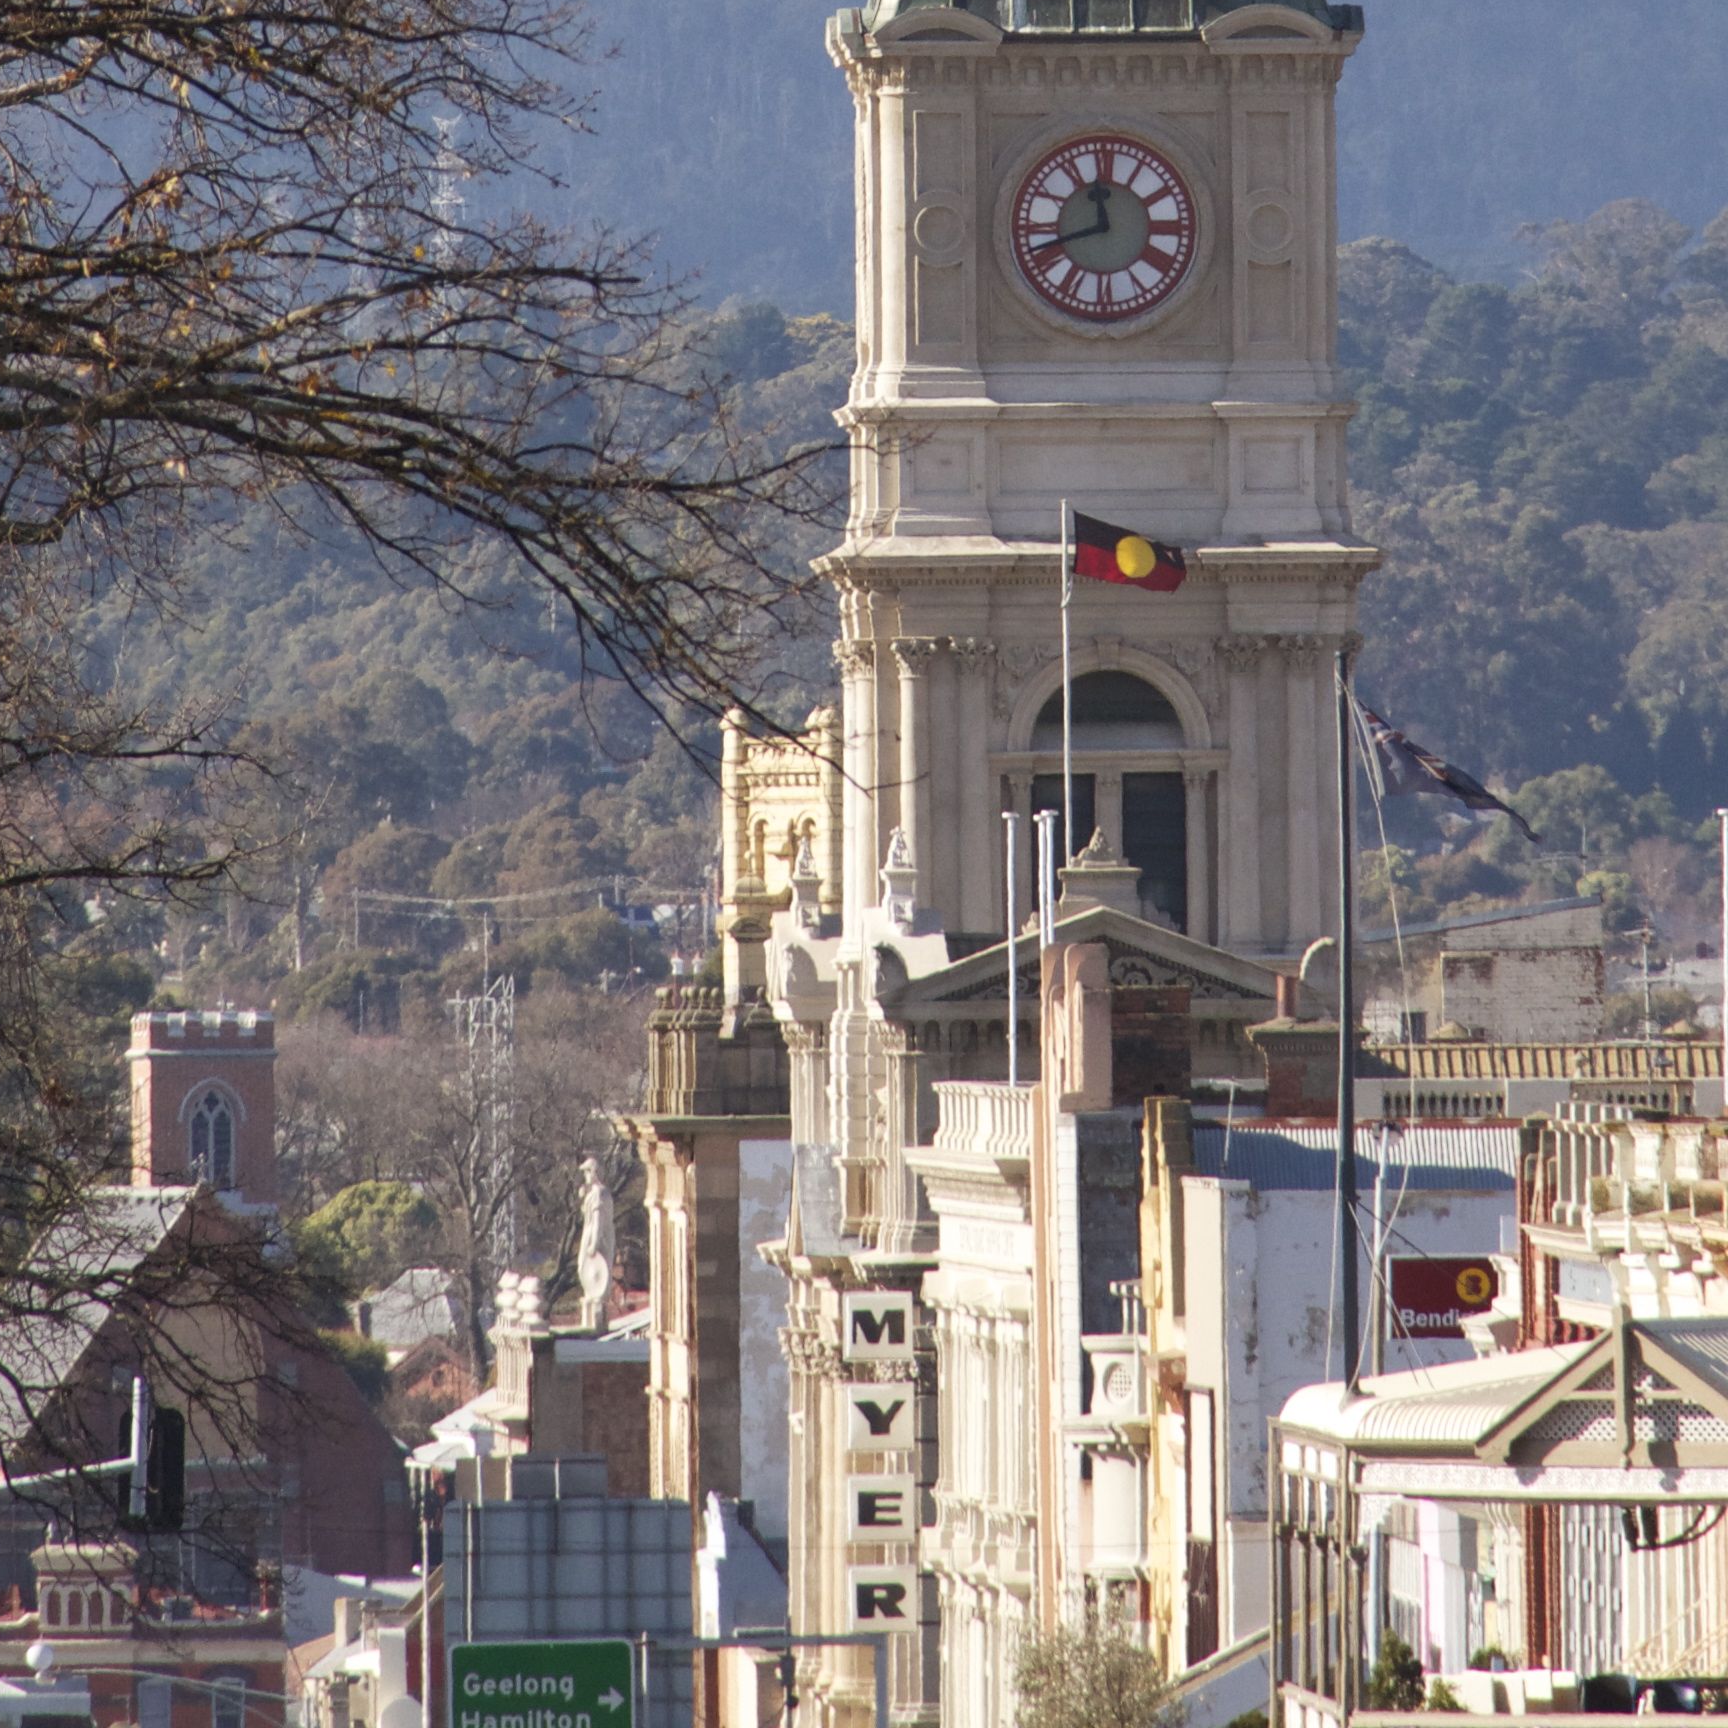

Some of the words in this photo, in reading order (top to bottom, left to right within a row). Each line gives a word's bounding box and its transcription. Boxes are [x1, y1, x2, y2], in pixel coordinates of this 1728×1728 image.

[851, 1309, 907, 1619] MYER
[463, 1673, 575, 1702] Geelong
[461, 1710, 591, 1728] Hamilton
